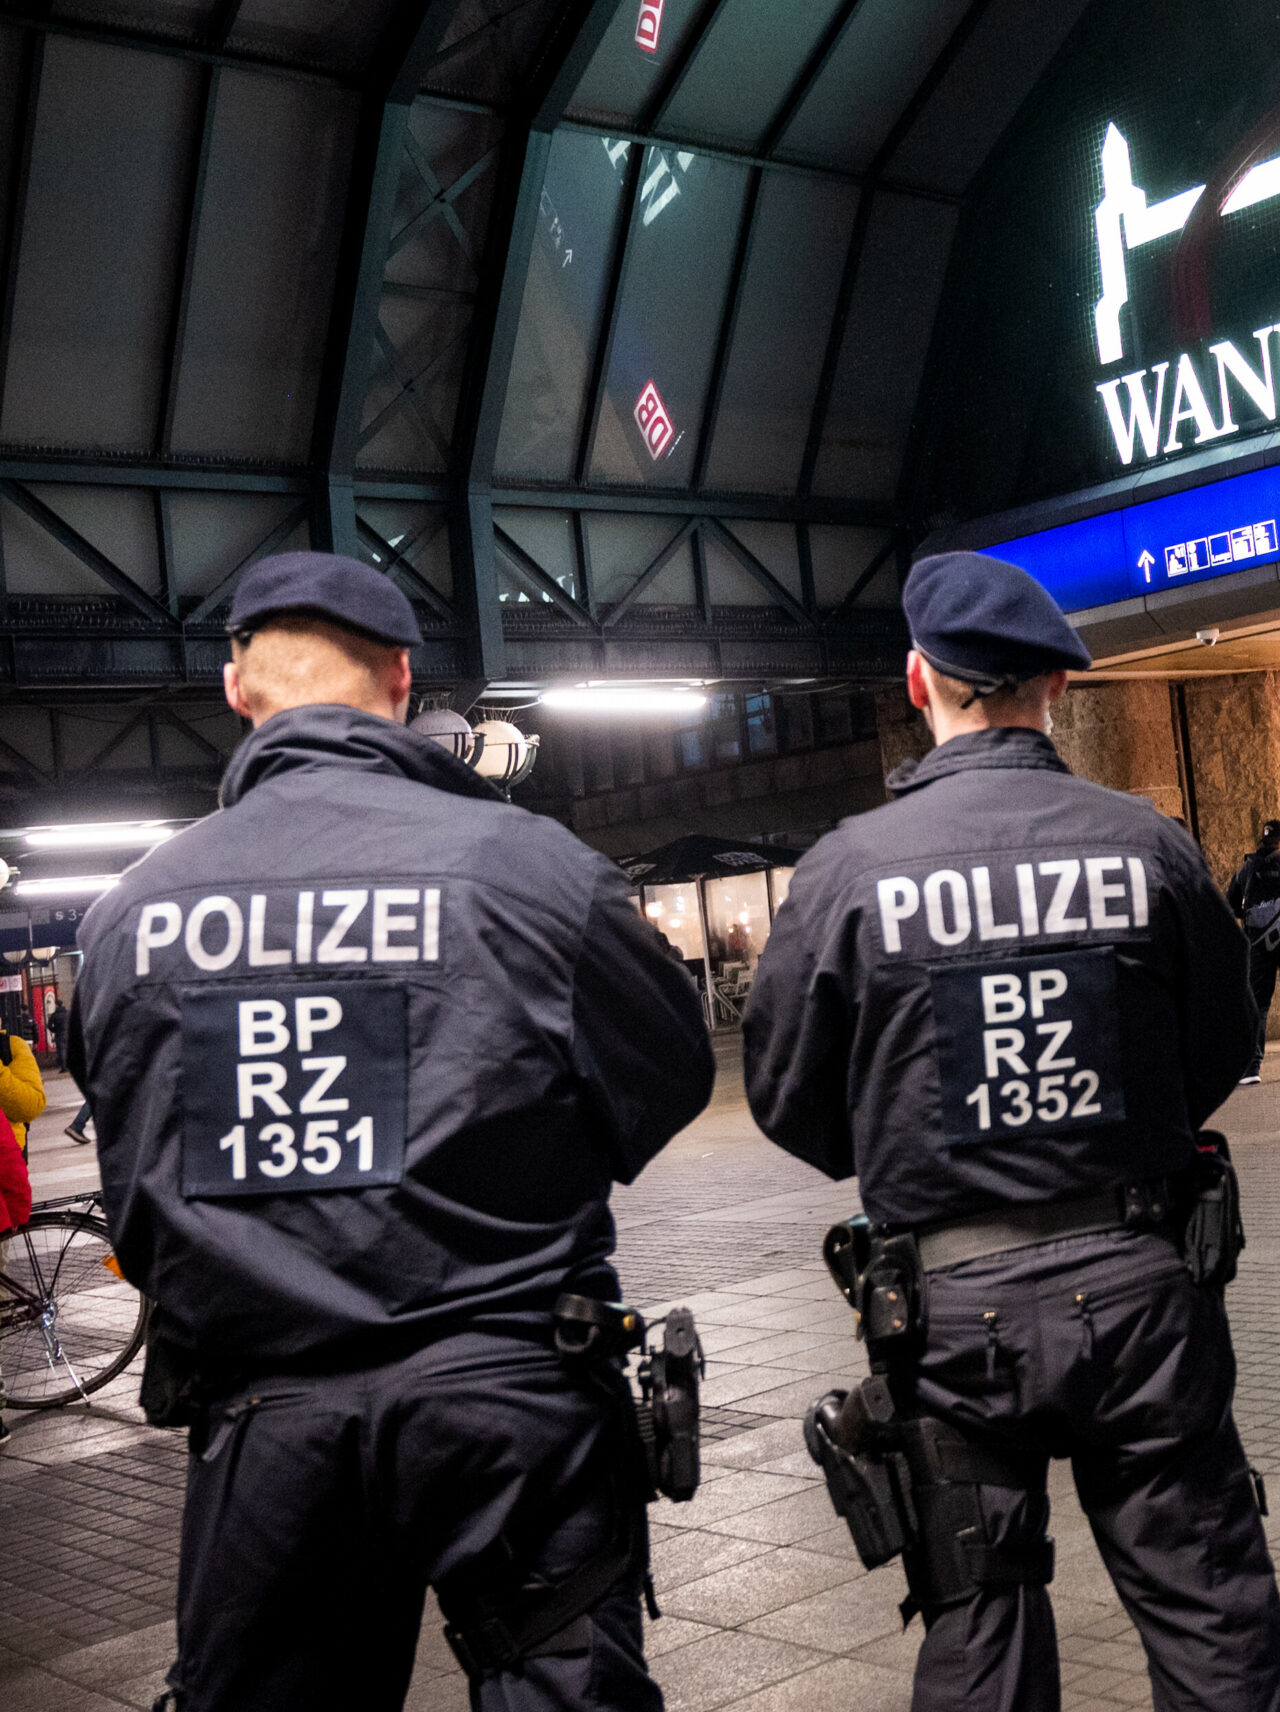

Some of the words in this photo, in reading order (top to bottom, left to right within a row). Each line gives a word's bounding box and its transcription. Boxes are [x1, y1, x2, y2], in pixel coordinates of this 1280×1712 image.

[136, 888, 441, 977] POLIZEI
[877, 856, 1149, 954] POLIZEI
[238, 995, 344, 1057] BP
[981, 968, 1068, 1024] BP
[982, 1020, 1076, 1079] RZ
[236, 1055, 350, 1119] RZ
[966, 1069, 1102, 1131] 1352
[218, 1115, 374, 1180] 1351
